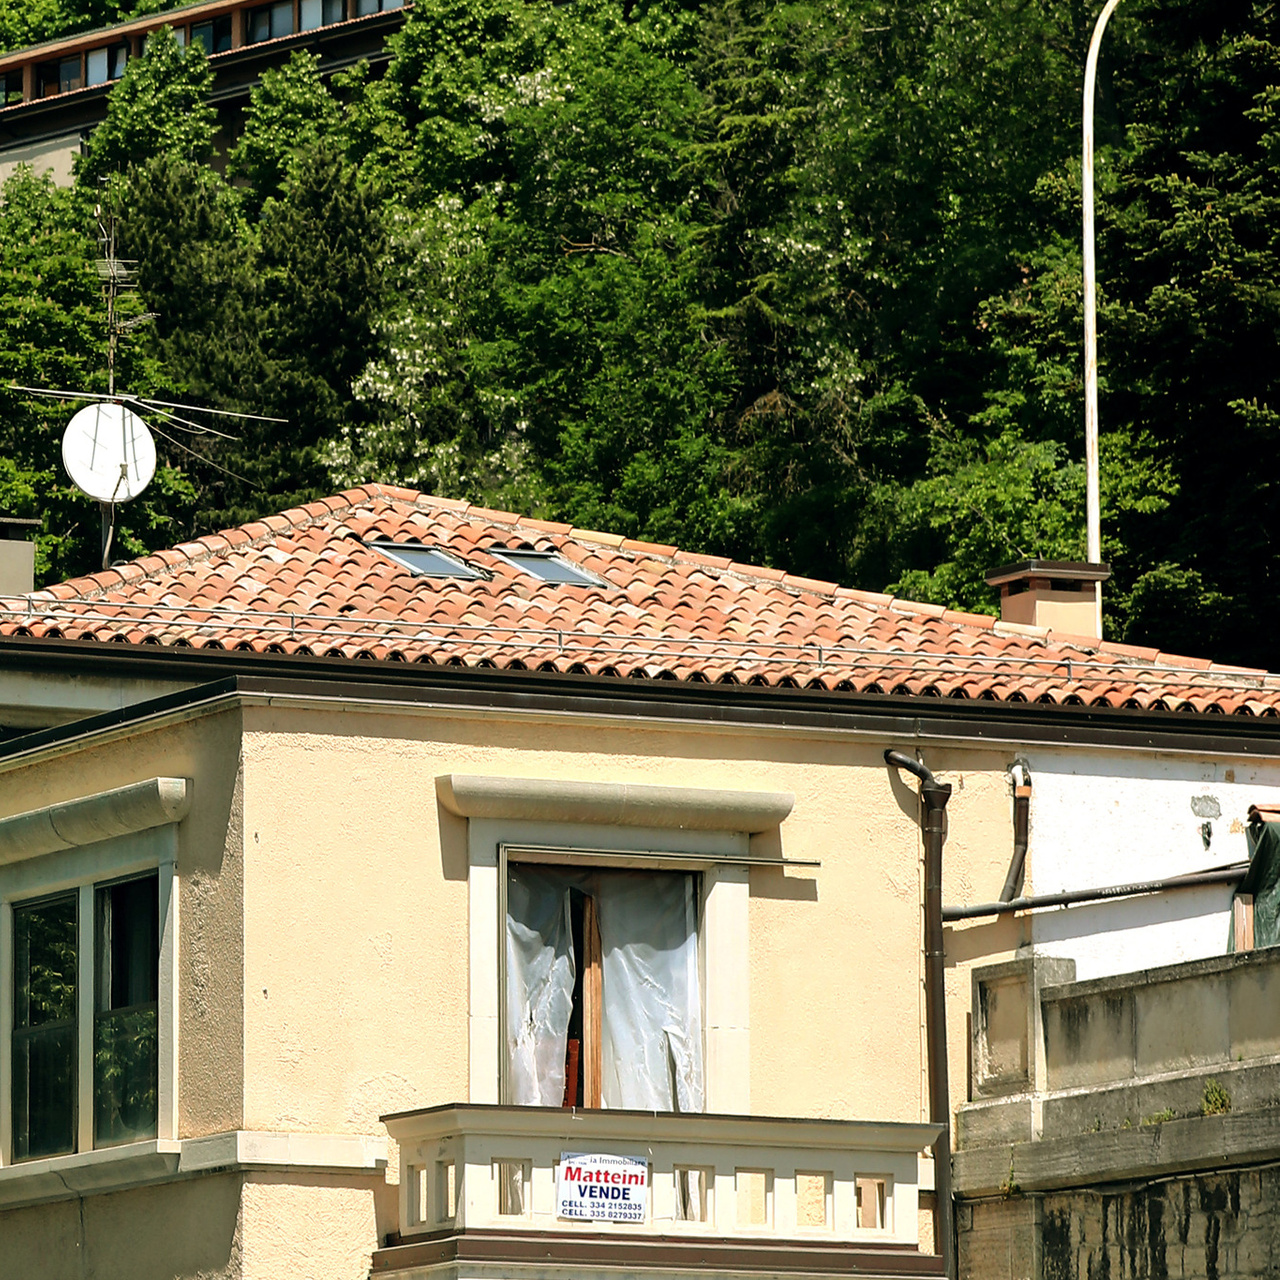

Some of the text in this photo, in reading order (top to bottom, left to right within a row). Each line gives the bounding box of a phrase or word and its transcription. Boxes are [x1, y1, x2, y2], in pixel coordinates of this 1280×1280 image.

[564, 1166, 645, 1185] Matteini
[578, 1184, 631, 1201] VENDE
[561, 1199, 642, 1211] CELL. 334 2152835
[561, 1208, 642, 1220] CELL. 335 8279337
